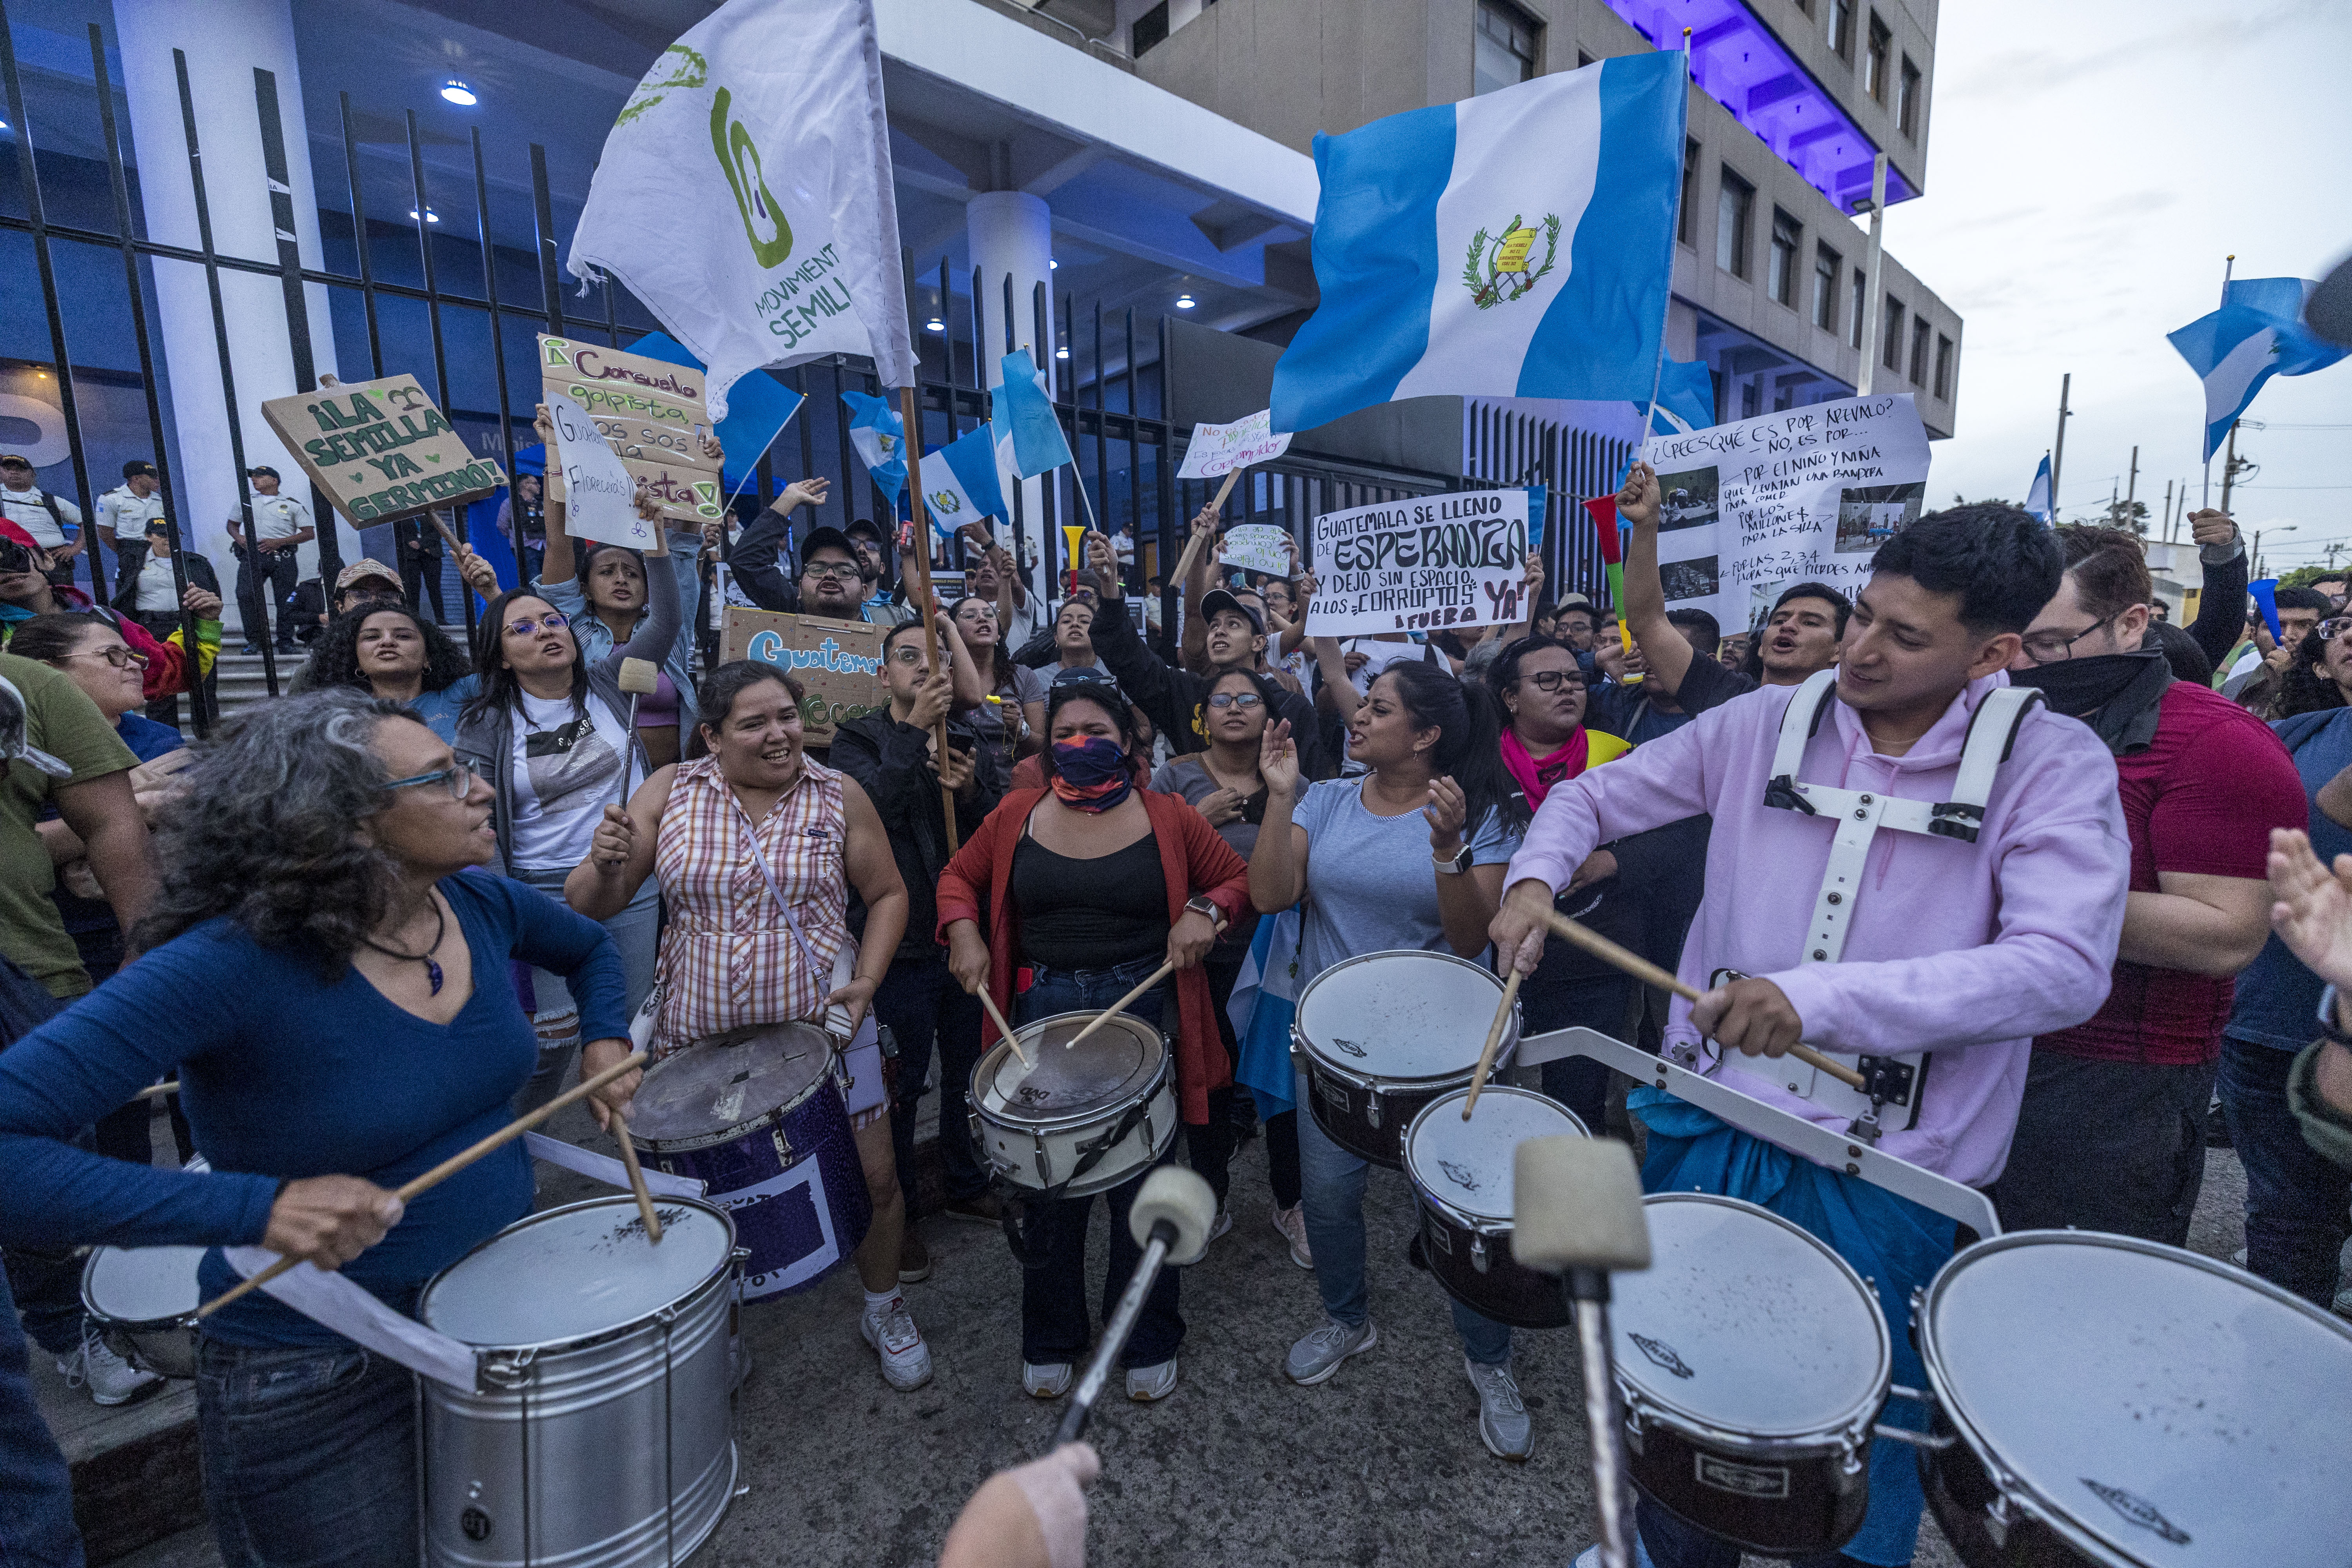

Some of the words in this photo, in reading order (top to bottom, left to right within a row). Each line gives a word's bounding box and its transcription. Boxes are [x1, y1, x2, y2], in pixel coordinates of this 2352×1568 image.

[755, 243, 839, 318] MOVIMIENT
[769, 277, 852, 349] SEMIL
[308, 393, 384, 431] ¡LA
[305, 409, 452, 467] SEMILLA
[641, 429, 688, 452] sos
[1752, 425, 1779, 443] ES
[1798, 432, 1817, 446] ES
[367, 452, 423, 481] YA
[1744, 465, 1769, 486] POR
[1831, 451, 1839, 466] Y
[348, 459, 505, 520] GERMINÓ!
[1317, 509, 1408, 541] GUATEMALA
[1414, 505, 1435, 524] SE
[1442, 496, 1502, 520] LLENO
[1760, 503, 1784, 519] LOS
[1317, 542, 1332, 557] DE
[1334, 518, 1526, 572] ESPERANZA
[1772, 526, 1788, 538] LA
[1314, 574, 1326, 597] Y
[1333, 572, 1370, 594] DEJO
[1379, 571, 1403, 587] SIN
[1410, 570, 1471, 589] ESPACIO
[1310, 601, 1321, 615] A
[1323, 599, 1347, 614] LOS
[748, 630, 884, 676] Guatema
